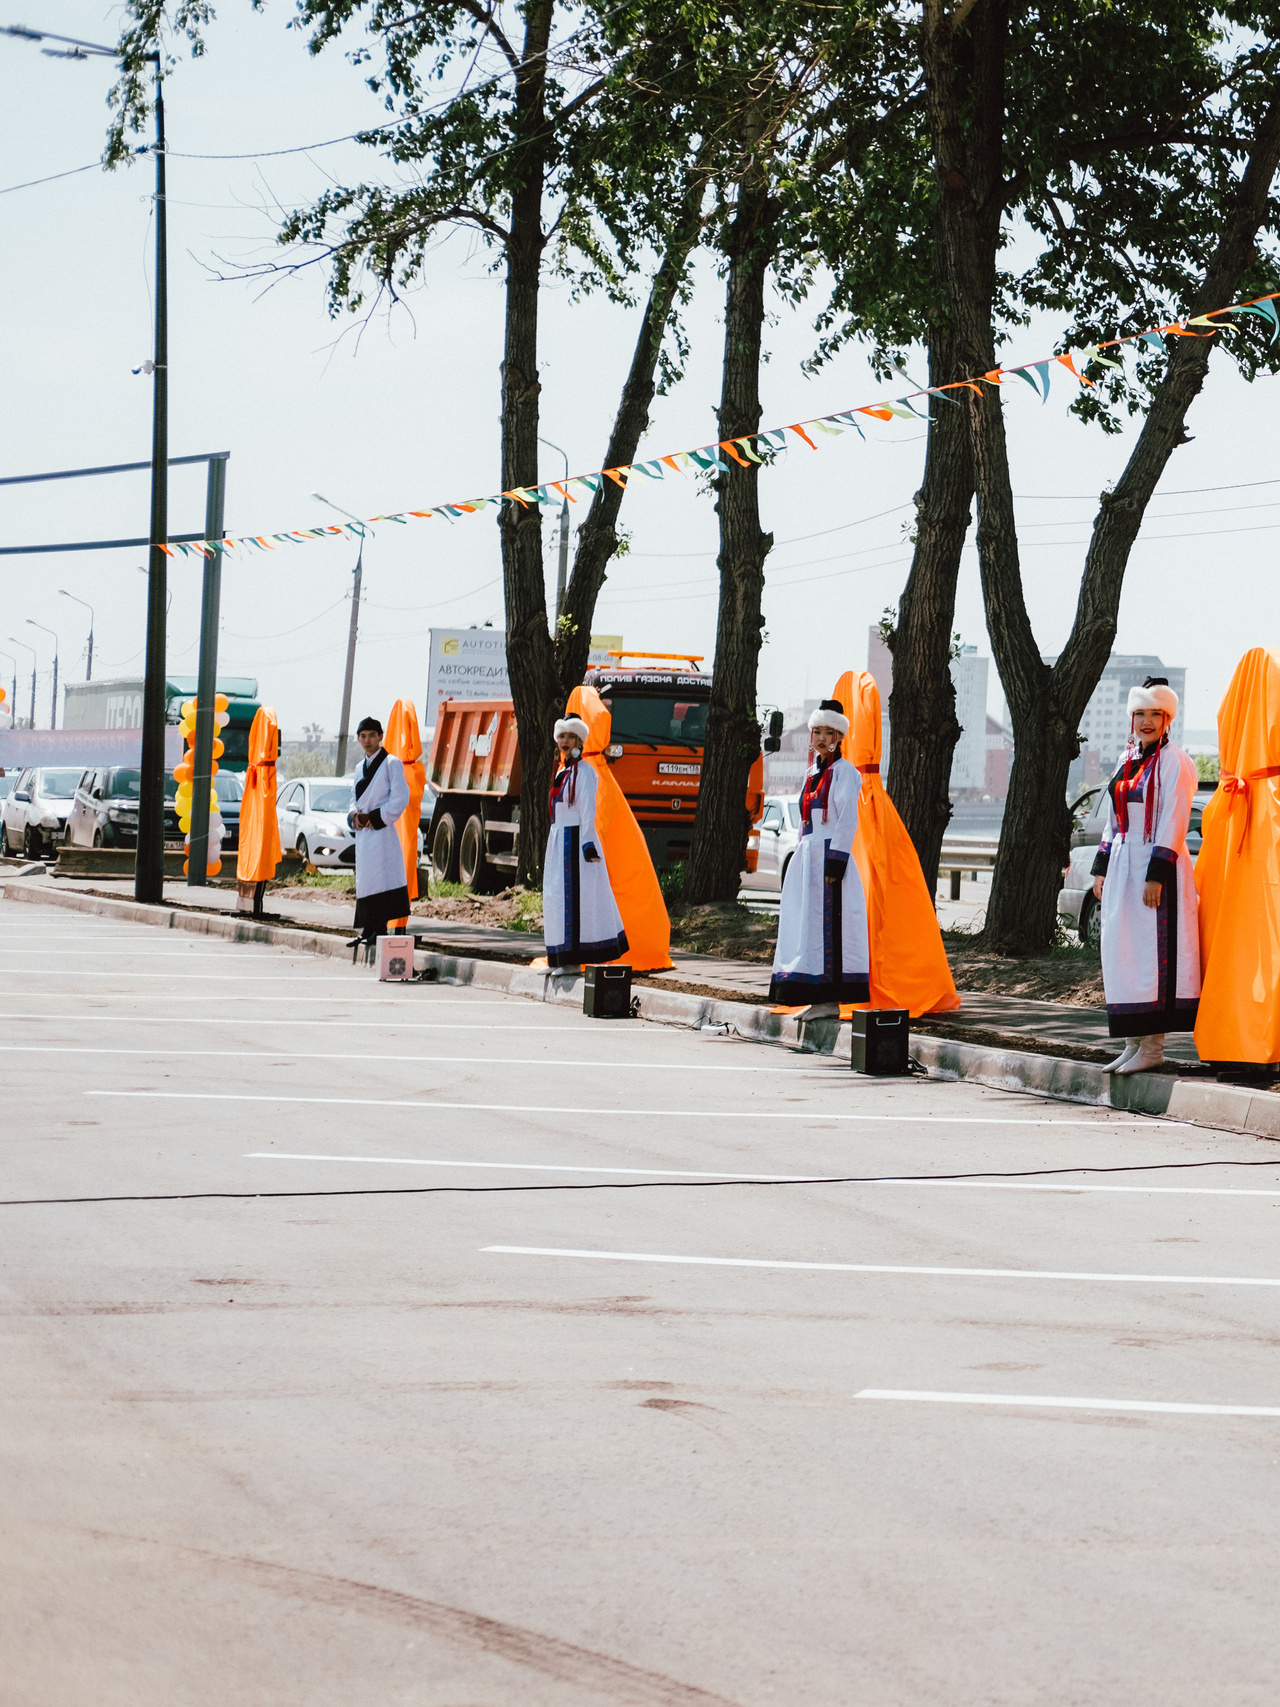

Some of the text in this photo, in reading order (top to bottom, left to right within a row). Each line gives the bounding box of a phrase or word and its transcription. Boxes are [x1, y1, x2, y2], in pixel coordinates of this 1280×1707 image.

[463, 640, 506, 649] AUTOTI
[600, 675, 633, 683] ПОЛИВ
[635, 675, 672, 684] ГАЗОНА
